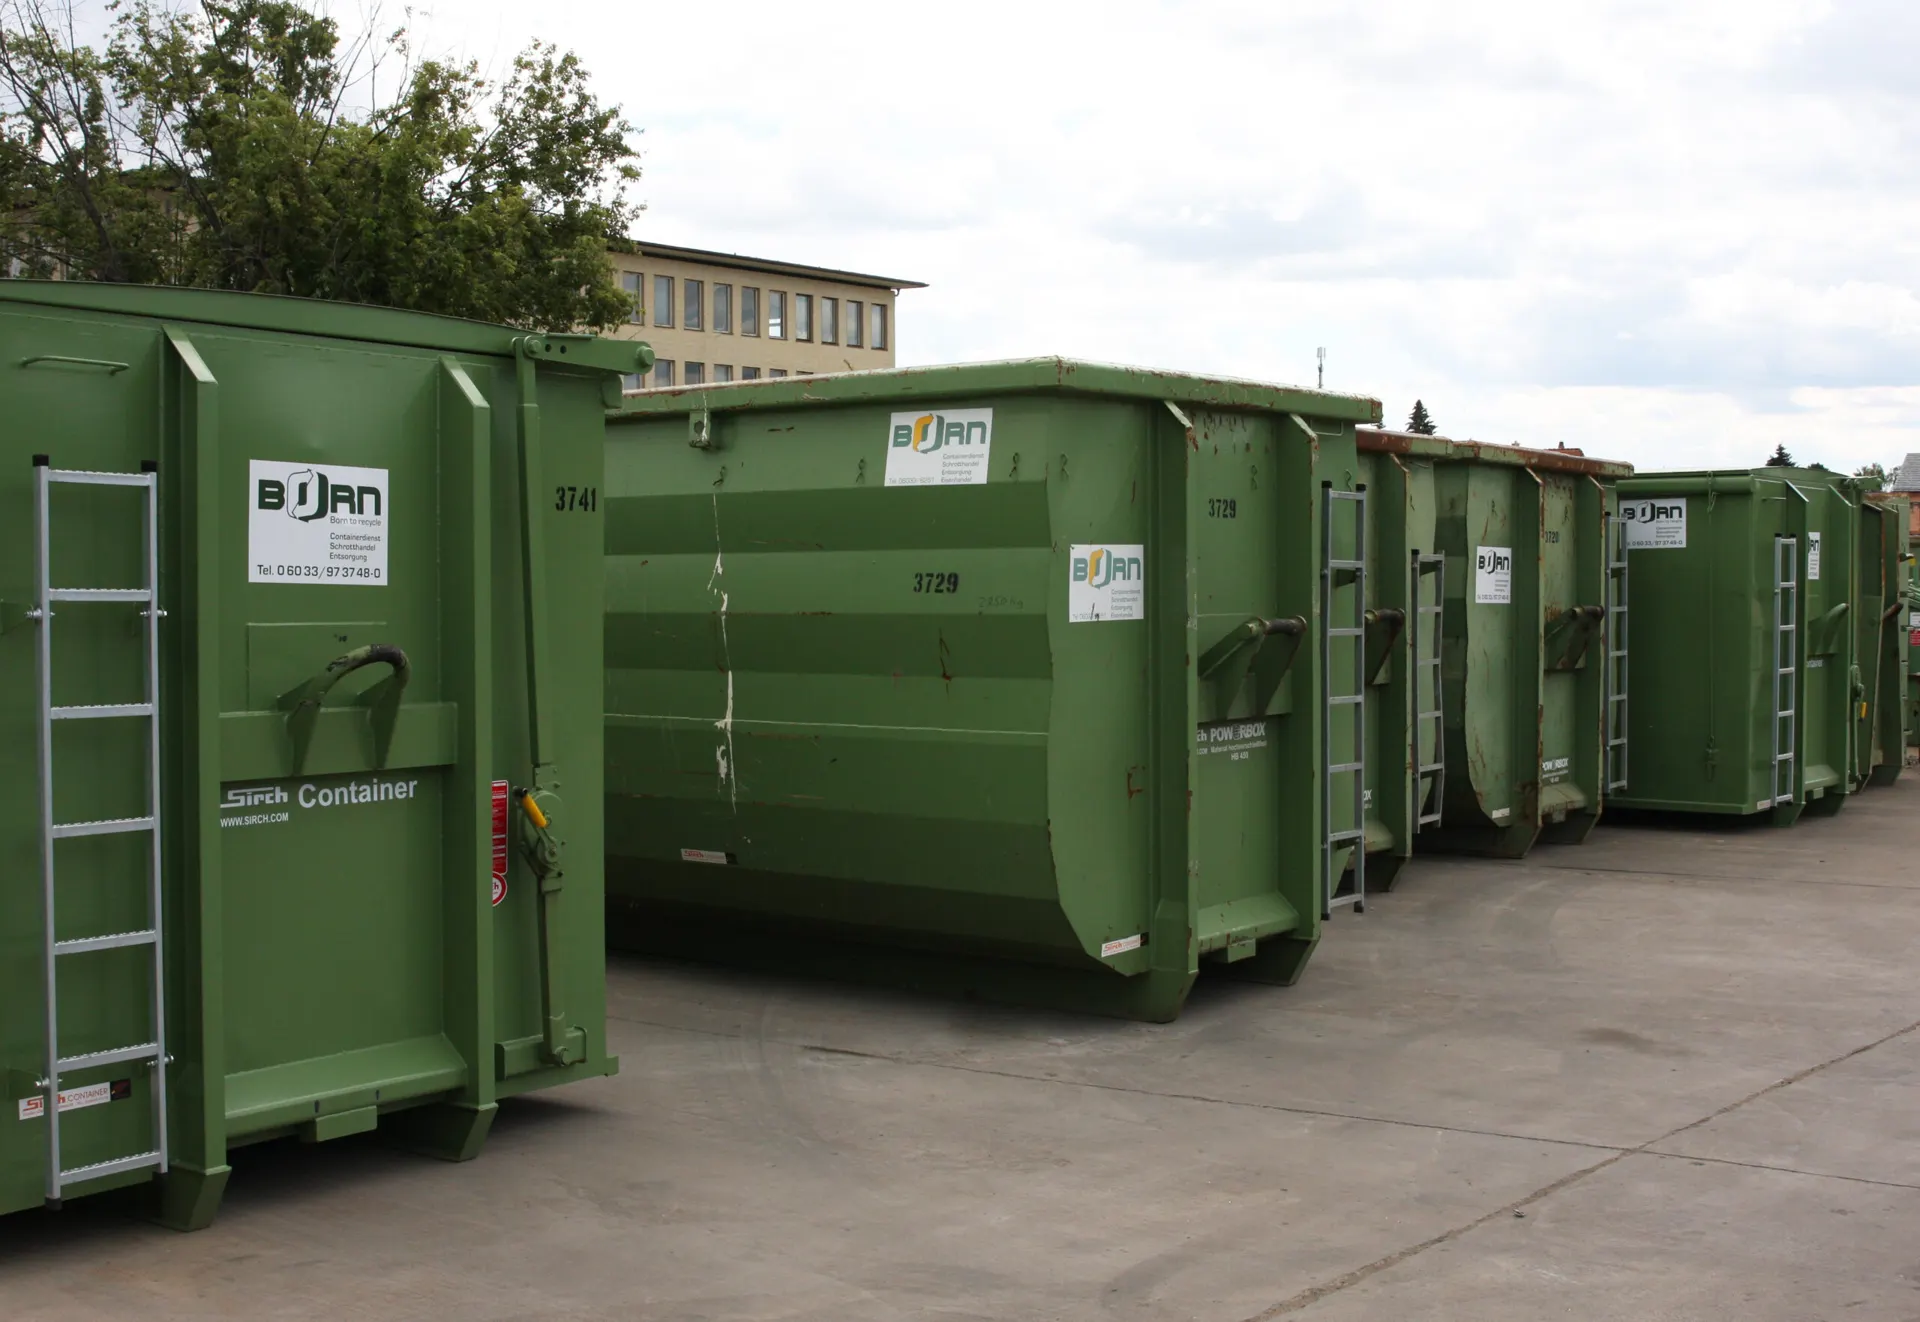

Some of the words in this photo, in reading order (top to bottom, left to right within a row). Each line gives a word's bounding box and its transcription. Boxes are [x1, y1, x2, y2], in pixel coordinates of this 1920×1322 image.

[892, 413, 987, 454] BORN
[258, 468, 382, 523] BORN
[555, 486, 597, 512] 3741
[1208, 498, 1237, 519] 3729
[330, 515, 348, 524] Born
[350, 517, 357, 525] to
[358, 518, 382, 527] recycle
[330, 532, 381, 542] Containerdienst
[330, 542, 376, 551] Schrotthandel
[329, 552, 368, 562] Entsorgung
[1478, 550, 1510, 574] BORN
[257, 564, 274, 576] Tel.
[1072, 548, 1142, 590] BORN
[913, 572, 959, 594] 3729
[220, 786, 288, 808] Sirch
[298, 778, 418, 808] Container
[220, 812, 289, 827] WWW.SIRCH.COM
[67, 1087, 108, 1102] CONTAINER
